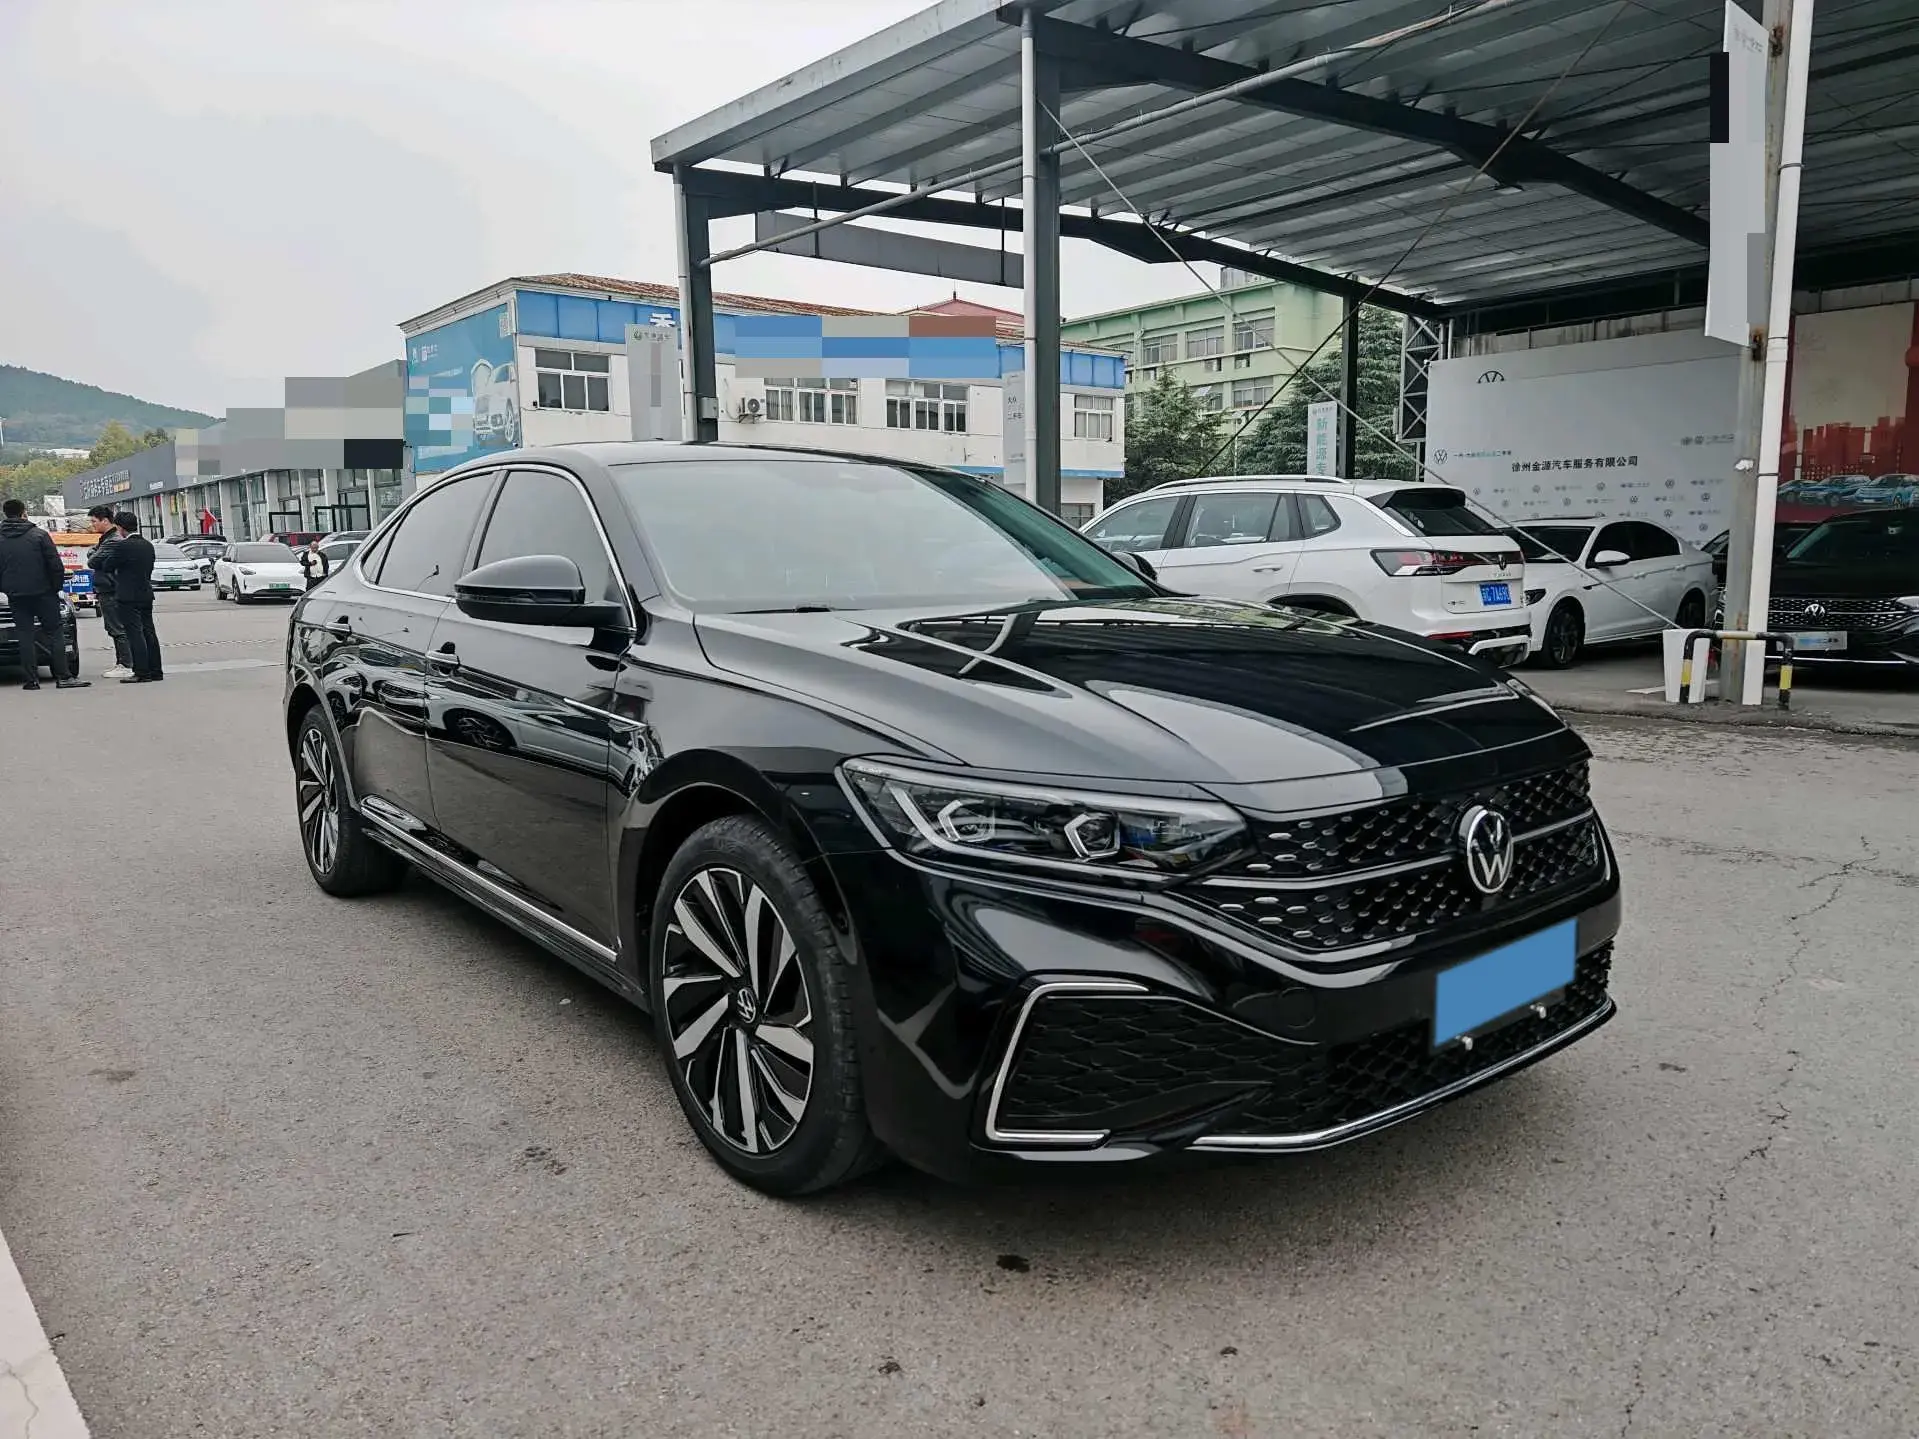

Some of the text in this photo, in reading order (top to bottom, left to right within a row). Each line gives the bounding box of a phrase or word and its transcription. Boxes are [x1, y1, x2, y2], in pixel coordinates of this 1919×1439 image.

[1511, 456, 1638, 473] 徐州金源汽车服务有限公司
